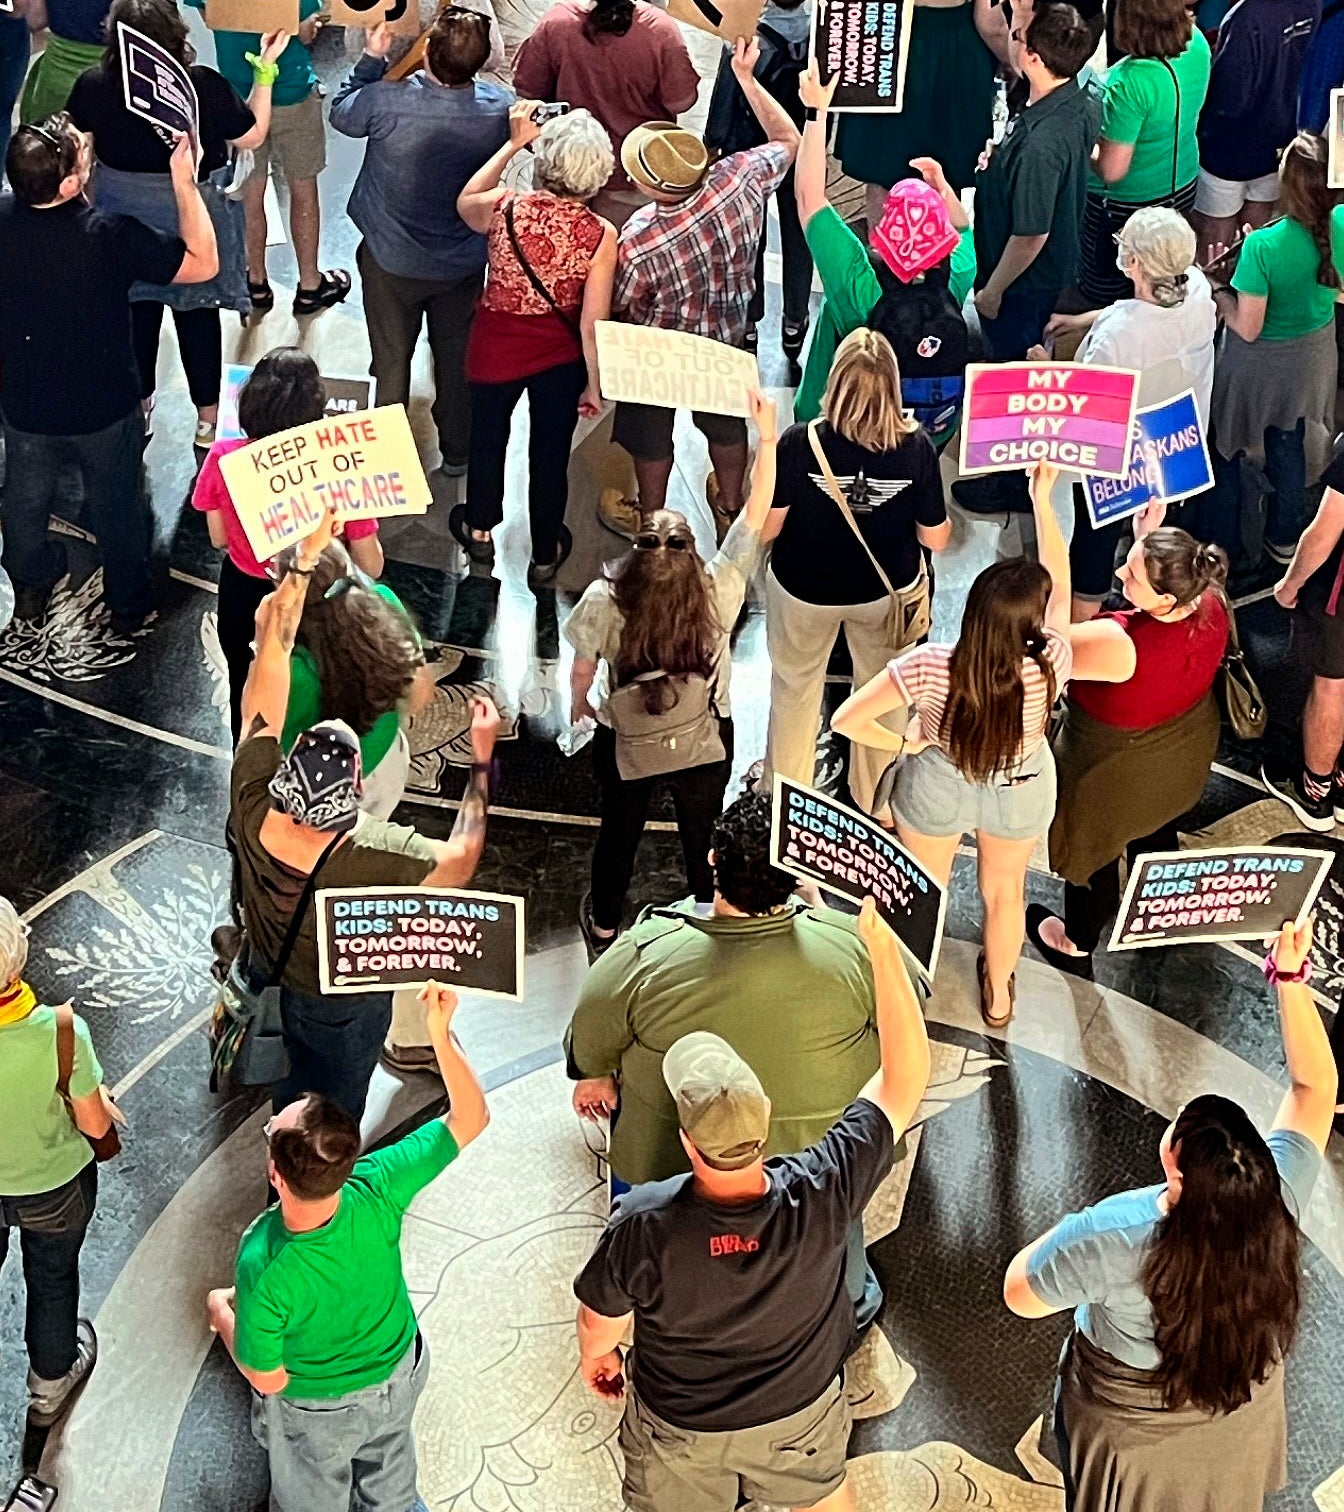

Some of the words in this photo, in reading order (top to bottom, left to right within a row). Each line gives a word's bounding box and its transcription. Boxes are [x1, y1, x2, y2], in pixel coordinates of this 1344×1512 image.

[830, 1, 844, 12] &
[865, 2, 880, 35] KIDS:
[882, 2, 896, 53] DEFEND
[828, 13, 844, 75] FOREVER.
[842, 2, 862, 86] TOMORROW,
[858, 36, 875, 86] TODAY,
[876, 54, 895, 97] TRANS
[1028, 371, 1072, 388] MY
[1008, 394, 1088, 415] BODY
[1022, 418, 1066, 436] MY
[250, 436, 308, 474] KEEP
[316, 420, 376, 450] HATE
[989, 440, 1098, 466] CHOICE
[270, 460, 318, 493] OUT
[332, 450, 365, 472] OF
[259, 472, 406, 544] HEALTHCARE
[788, 807, 843, 845] KIDS:
[846, 833, 914, 900] TODAY,
[789, 792, 854, 838] DEFEND
[870, 837, 928, 894] TRANS
[787, 841, 801, 859] &
[805, 846, 895, 914] FOREVER.
[788, 826, 912, 916] TOMORROW,
[1146, 859, 1230, 881] DEFEND
[1232, 858, 1304, 876] TRANS
[1141, 879, 1196, 898] KIDS:
[1200, 874, 1278, 893] TODAY,
[334, 900, 420, 919] DEFEND
[428, 900, 498, 922] TRANS
[1136, 888, 1271, 914] TOMORROW,
[334, 919, 393, 936] KIDS:
[396, 917, 482, 940] TODAY,
[1130, 916, 1145, 932] &
[1147, 909, 1245, 930] FOREVER.
[334, 934, 482, 959] TOMORROW,
[336, 954, 352, 973] &
[356, 954, 462, 972] FOREVER.
